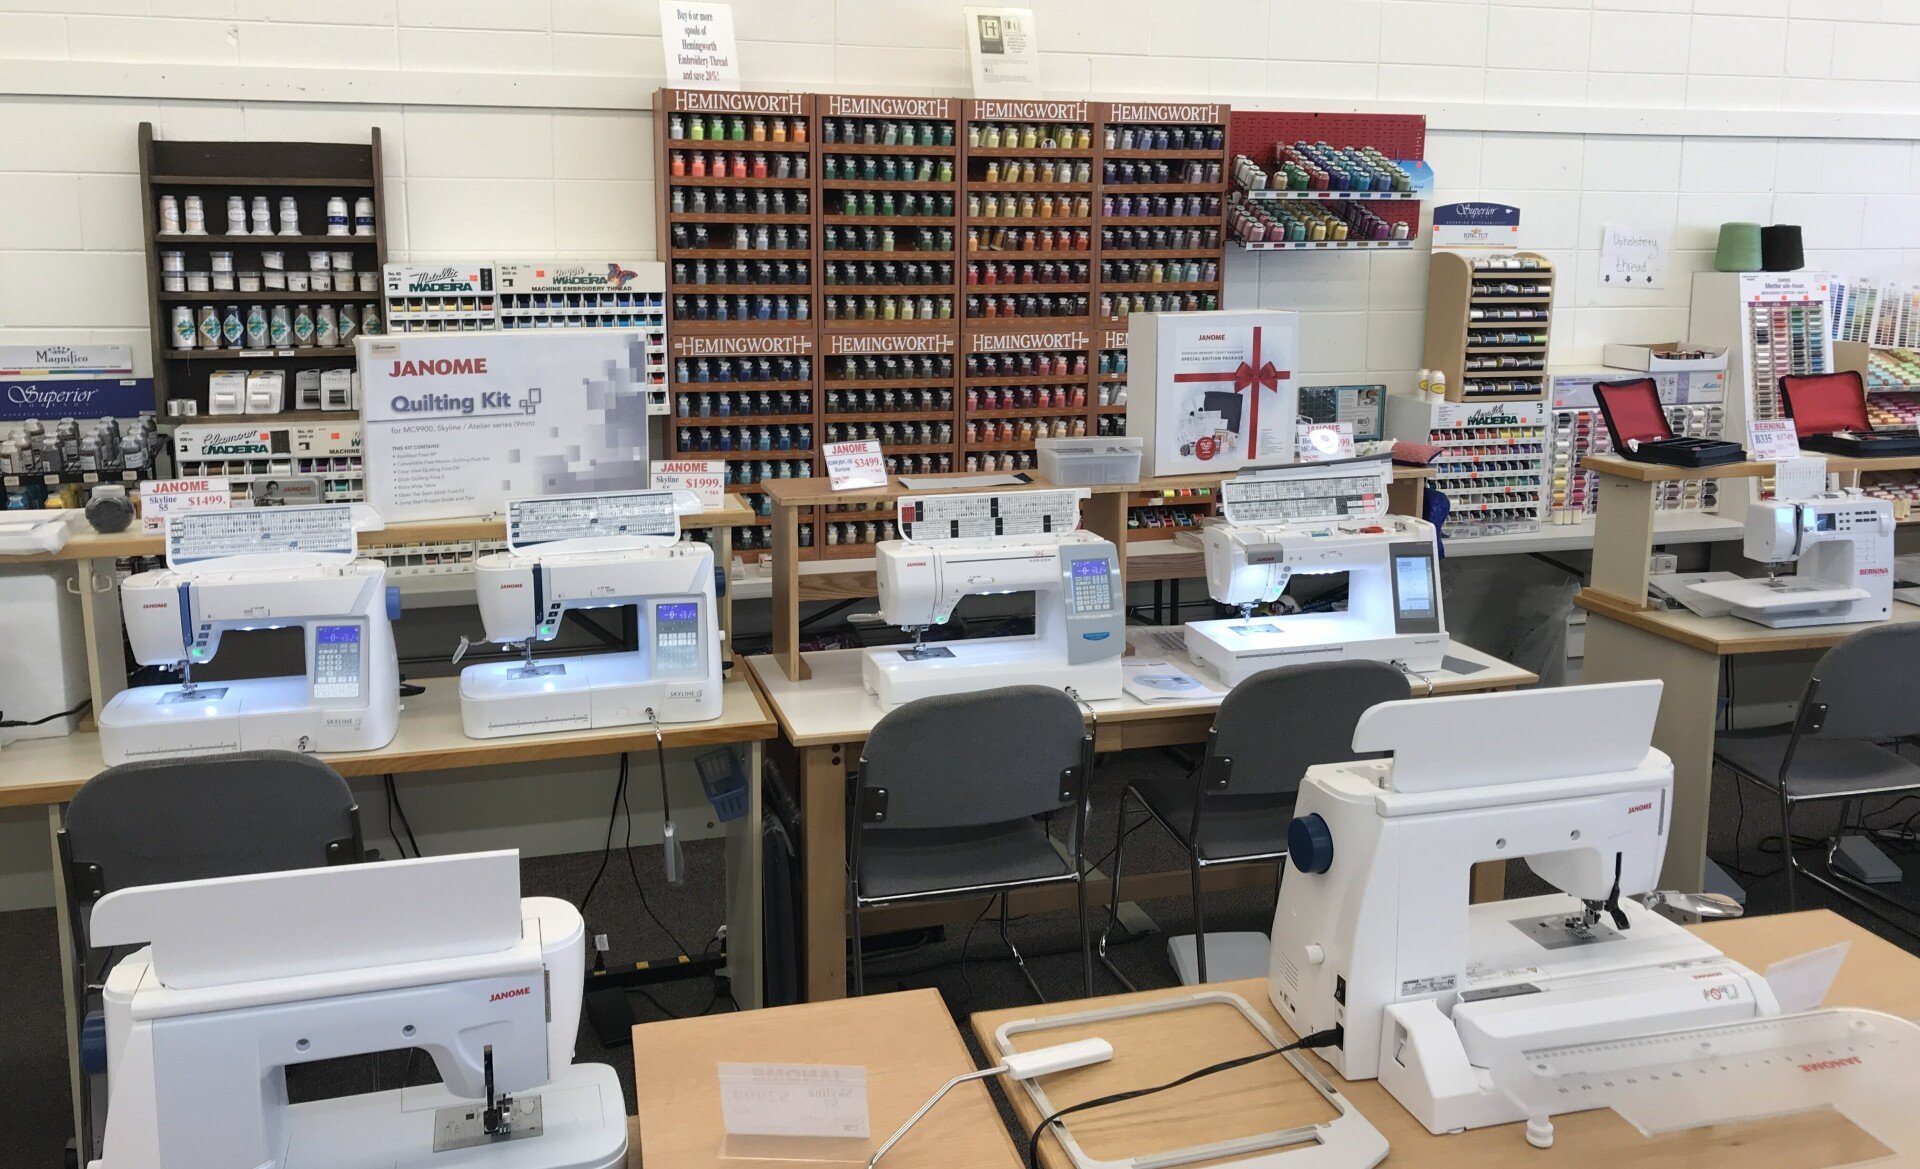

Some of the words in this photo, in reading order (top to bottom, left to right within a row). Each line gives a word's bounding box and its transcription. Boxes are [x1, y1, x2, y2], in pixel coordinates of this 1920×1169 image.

[677, 9, 687, 22] Buy
[700, 13, 713, 21] more
[685, 25, 700, 37] spools
[701, 26, 706, 36] of
[682, 40, 717, 53] Hemingworth
[678, 54, 708, 68] Embroidery
[709, 56, 728, 66] Thread
[683, 70, 692, 80] and
[675, 90, 802, 114] HEMINGWORTH
[829, 96, 948, 118] HEMINGWORTH
[975, 100, 1087, 122] HEMINGWORTH
[1111, 104, 1219, 124] HEMINGWORTH
[1456, 204, 1498, 218] Superior
[1614, 234, 1658, 260] Upholstery
[1616, 258, 1647, 272] thread
[409, 283, 473, 292] MADEIRA
[553, 276, 608, 285] MADEIRA
[682, 336, 806, 356] HEMINGWORTH
[832, 334, 947, 354] HEMINGWORTH
[973, 332, 1082, 351] HEMINGWORTH
[36, 350, 88, 364] Magnifico
[389, 358, 487, 378] JANOME
[8, 385, 96, 408] Superior
[391, 394, 474, 414] Quilting
[482, 392, 511, 408] Kit
[403, 425, 435, 434] MC9900,
[437, 424, 462, 433] Skyline
[468, 422, 490, 430] Atelier
[492, 421, 512, 429] series
[514, 420, 535, 428] (9mm)
[1468, 416, 1518, 426] MADEIRA
[1754, 422, 1786, 430] BERNINA
[1755, 434, 1772, 444] B335
[202, 445, 269, 455] MADEIRA
[832, 444, 868, 454] JANOME
[661, 463, 708, 472] JANOME
[854, 457, 882, 468] $3499.
[152, 480, 209, 494] JANOME
[656, 476, 679, 485] Skyline
[686, 478, 722, 488] $1999.
[150, 496, 177, 505] Skyline
[188, 495, 226, 507] $1499.
[159, 504, 169, 512] S5
[1859, 568, 1889, 576] BERNINA
[1628, 803, 1652, 814] JANOME
[489, 987, 530, 1002] JANOME
[1798, 1056, 1862, 1072] JANOME
